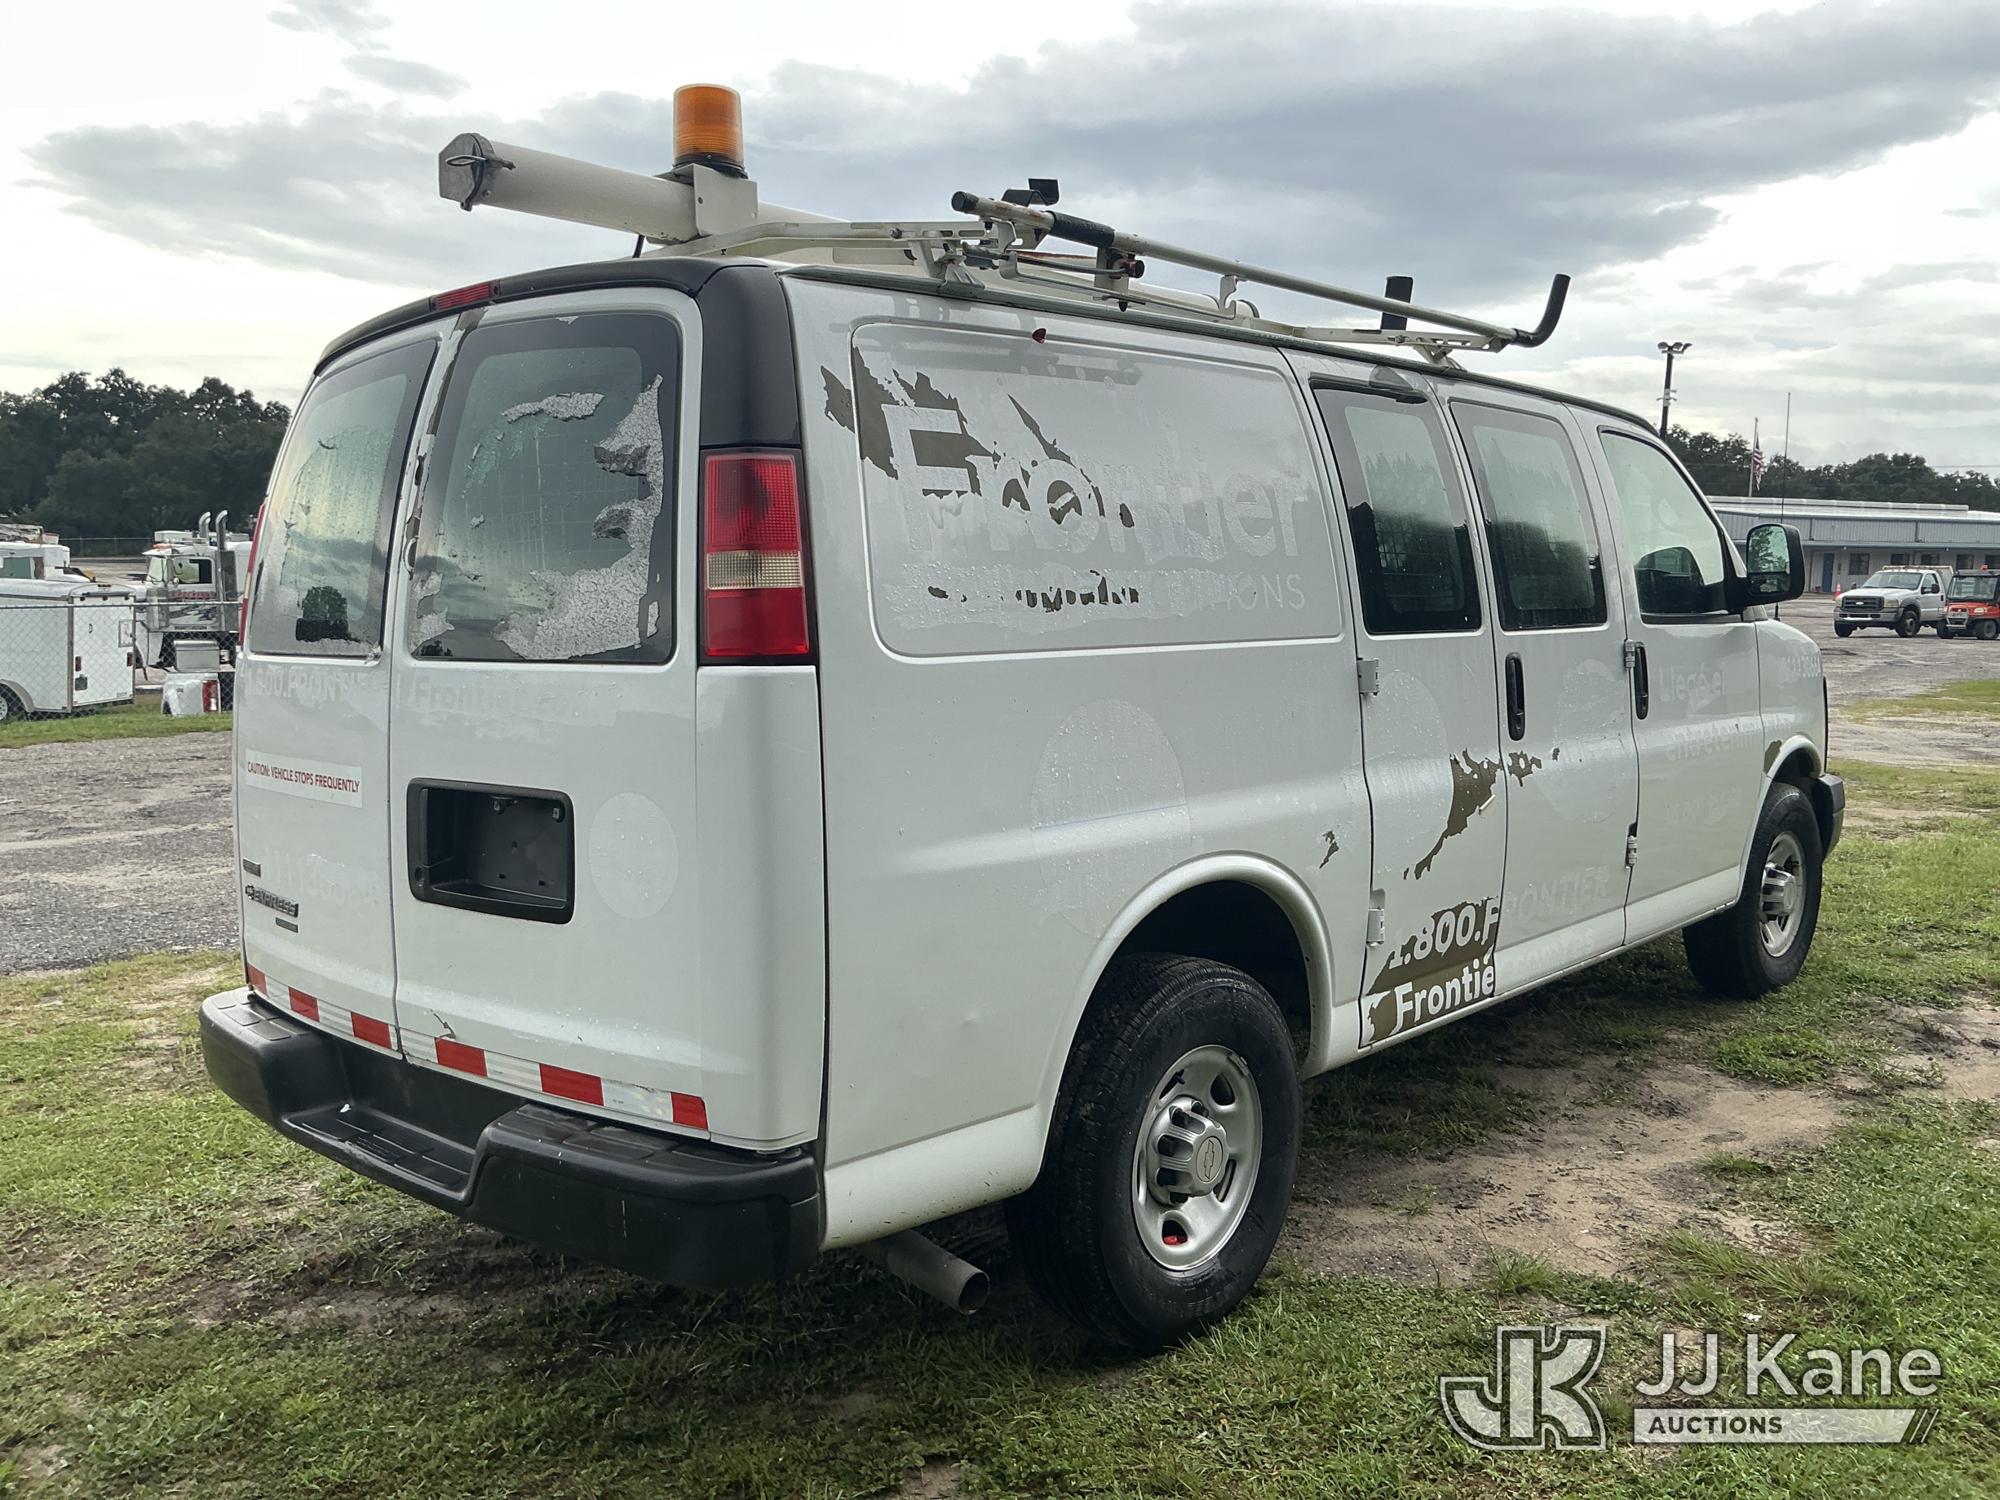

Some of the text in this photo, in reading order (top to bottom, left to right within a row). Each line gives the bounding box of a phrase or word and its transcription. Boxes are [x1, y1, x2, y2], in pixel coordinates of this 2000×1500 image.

[247, 761, 361, 792] CAUTION: VEHICLE STOPS FREQUENTLY
